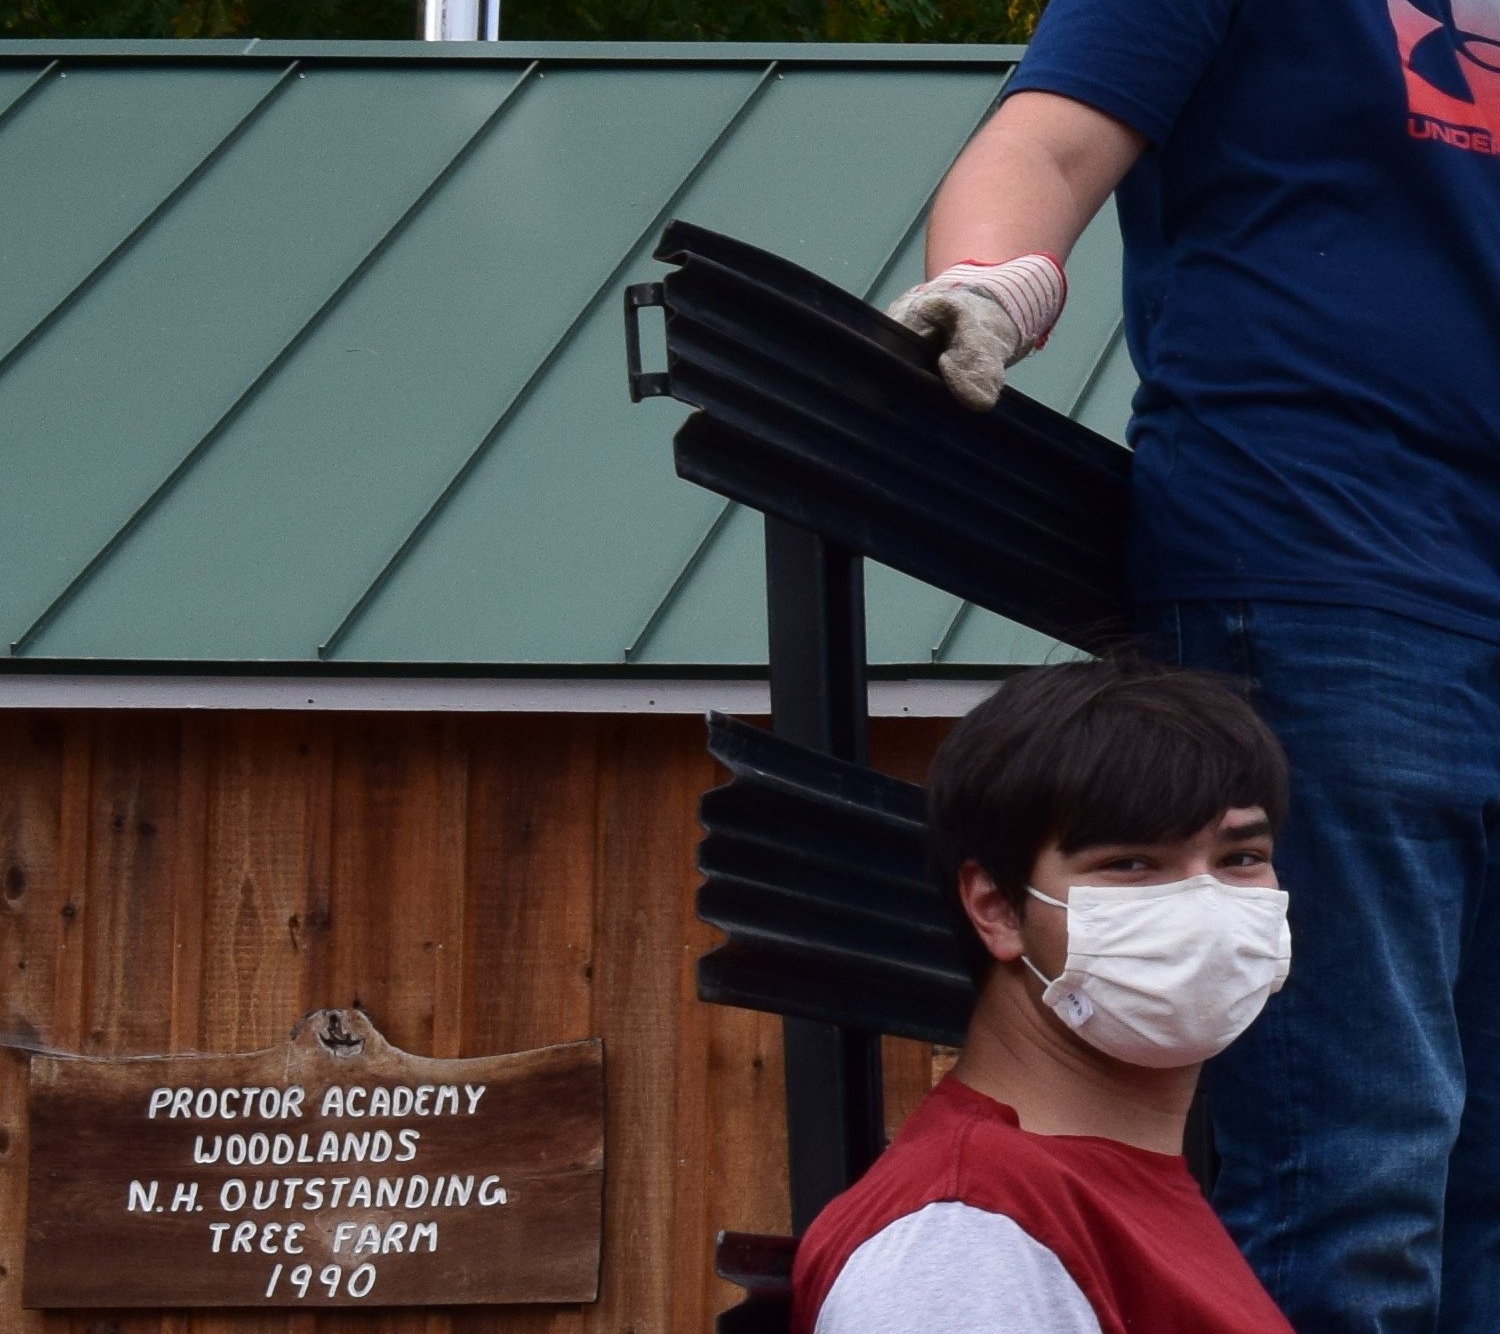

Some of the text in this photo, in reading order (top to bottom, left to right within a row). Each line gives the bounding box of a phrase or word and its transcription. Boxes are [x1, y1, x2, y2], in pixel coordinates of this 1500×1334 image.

[1409, 117, 1496, 153] UNDE
[149, 1085, 485, 1118] PROCTOR ACADEMY
[194, 1129, 420, 1165] WOODLANDS
[128, 1175, 507, 1212] N.H. OUTSTANDING
[210, 1221, 437, 1254] TREE FARM
[266, 1263, 376, 1298] 1990
